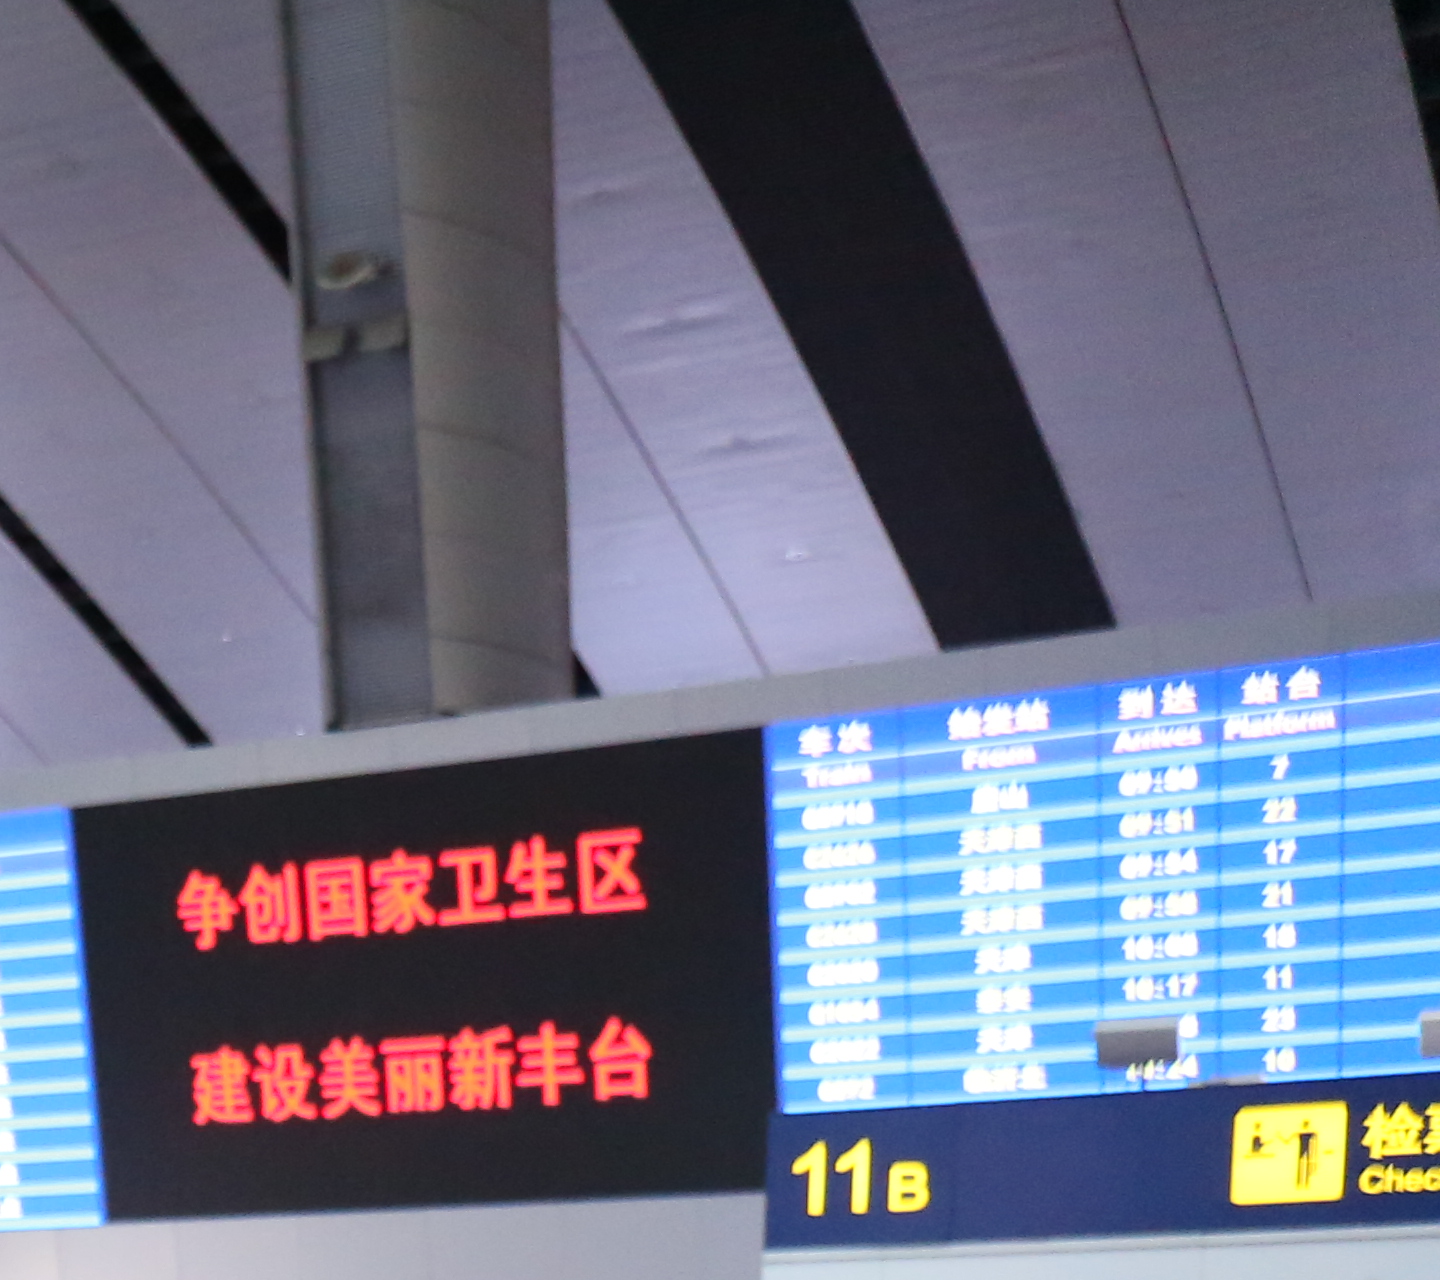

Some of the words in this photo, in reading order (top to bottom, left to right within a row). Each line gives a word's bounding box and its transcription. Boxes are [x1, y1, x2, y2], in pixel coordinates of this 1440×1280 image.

[1111, 723, 1203, 754] Arrives
[1222, 706, 1337, 742] Platform
[960, 743, 1037, 771] From
[800, 761, 873, 789] Train
[1262, 836, 1298, 865] 17
[177, 828, 647, 951] 争创国家卫生区
[1121, 970, 1199, 1000] 10:17
[1262, 962, 1294, 991] 11
[190, 1017, 652, 1126] 建设美丽新丰台
[792, 1139, 930, 1217] 11B
[1357, 1163, 1440, 1196] Chec
